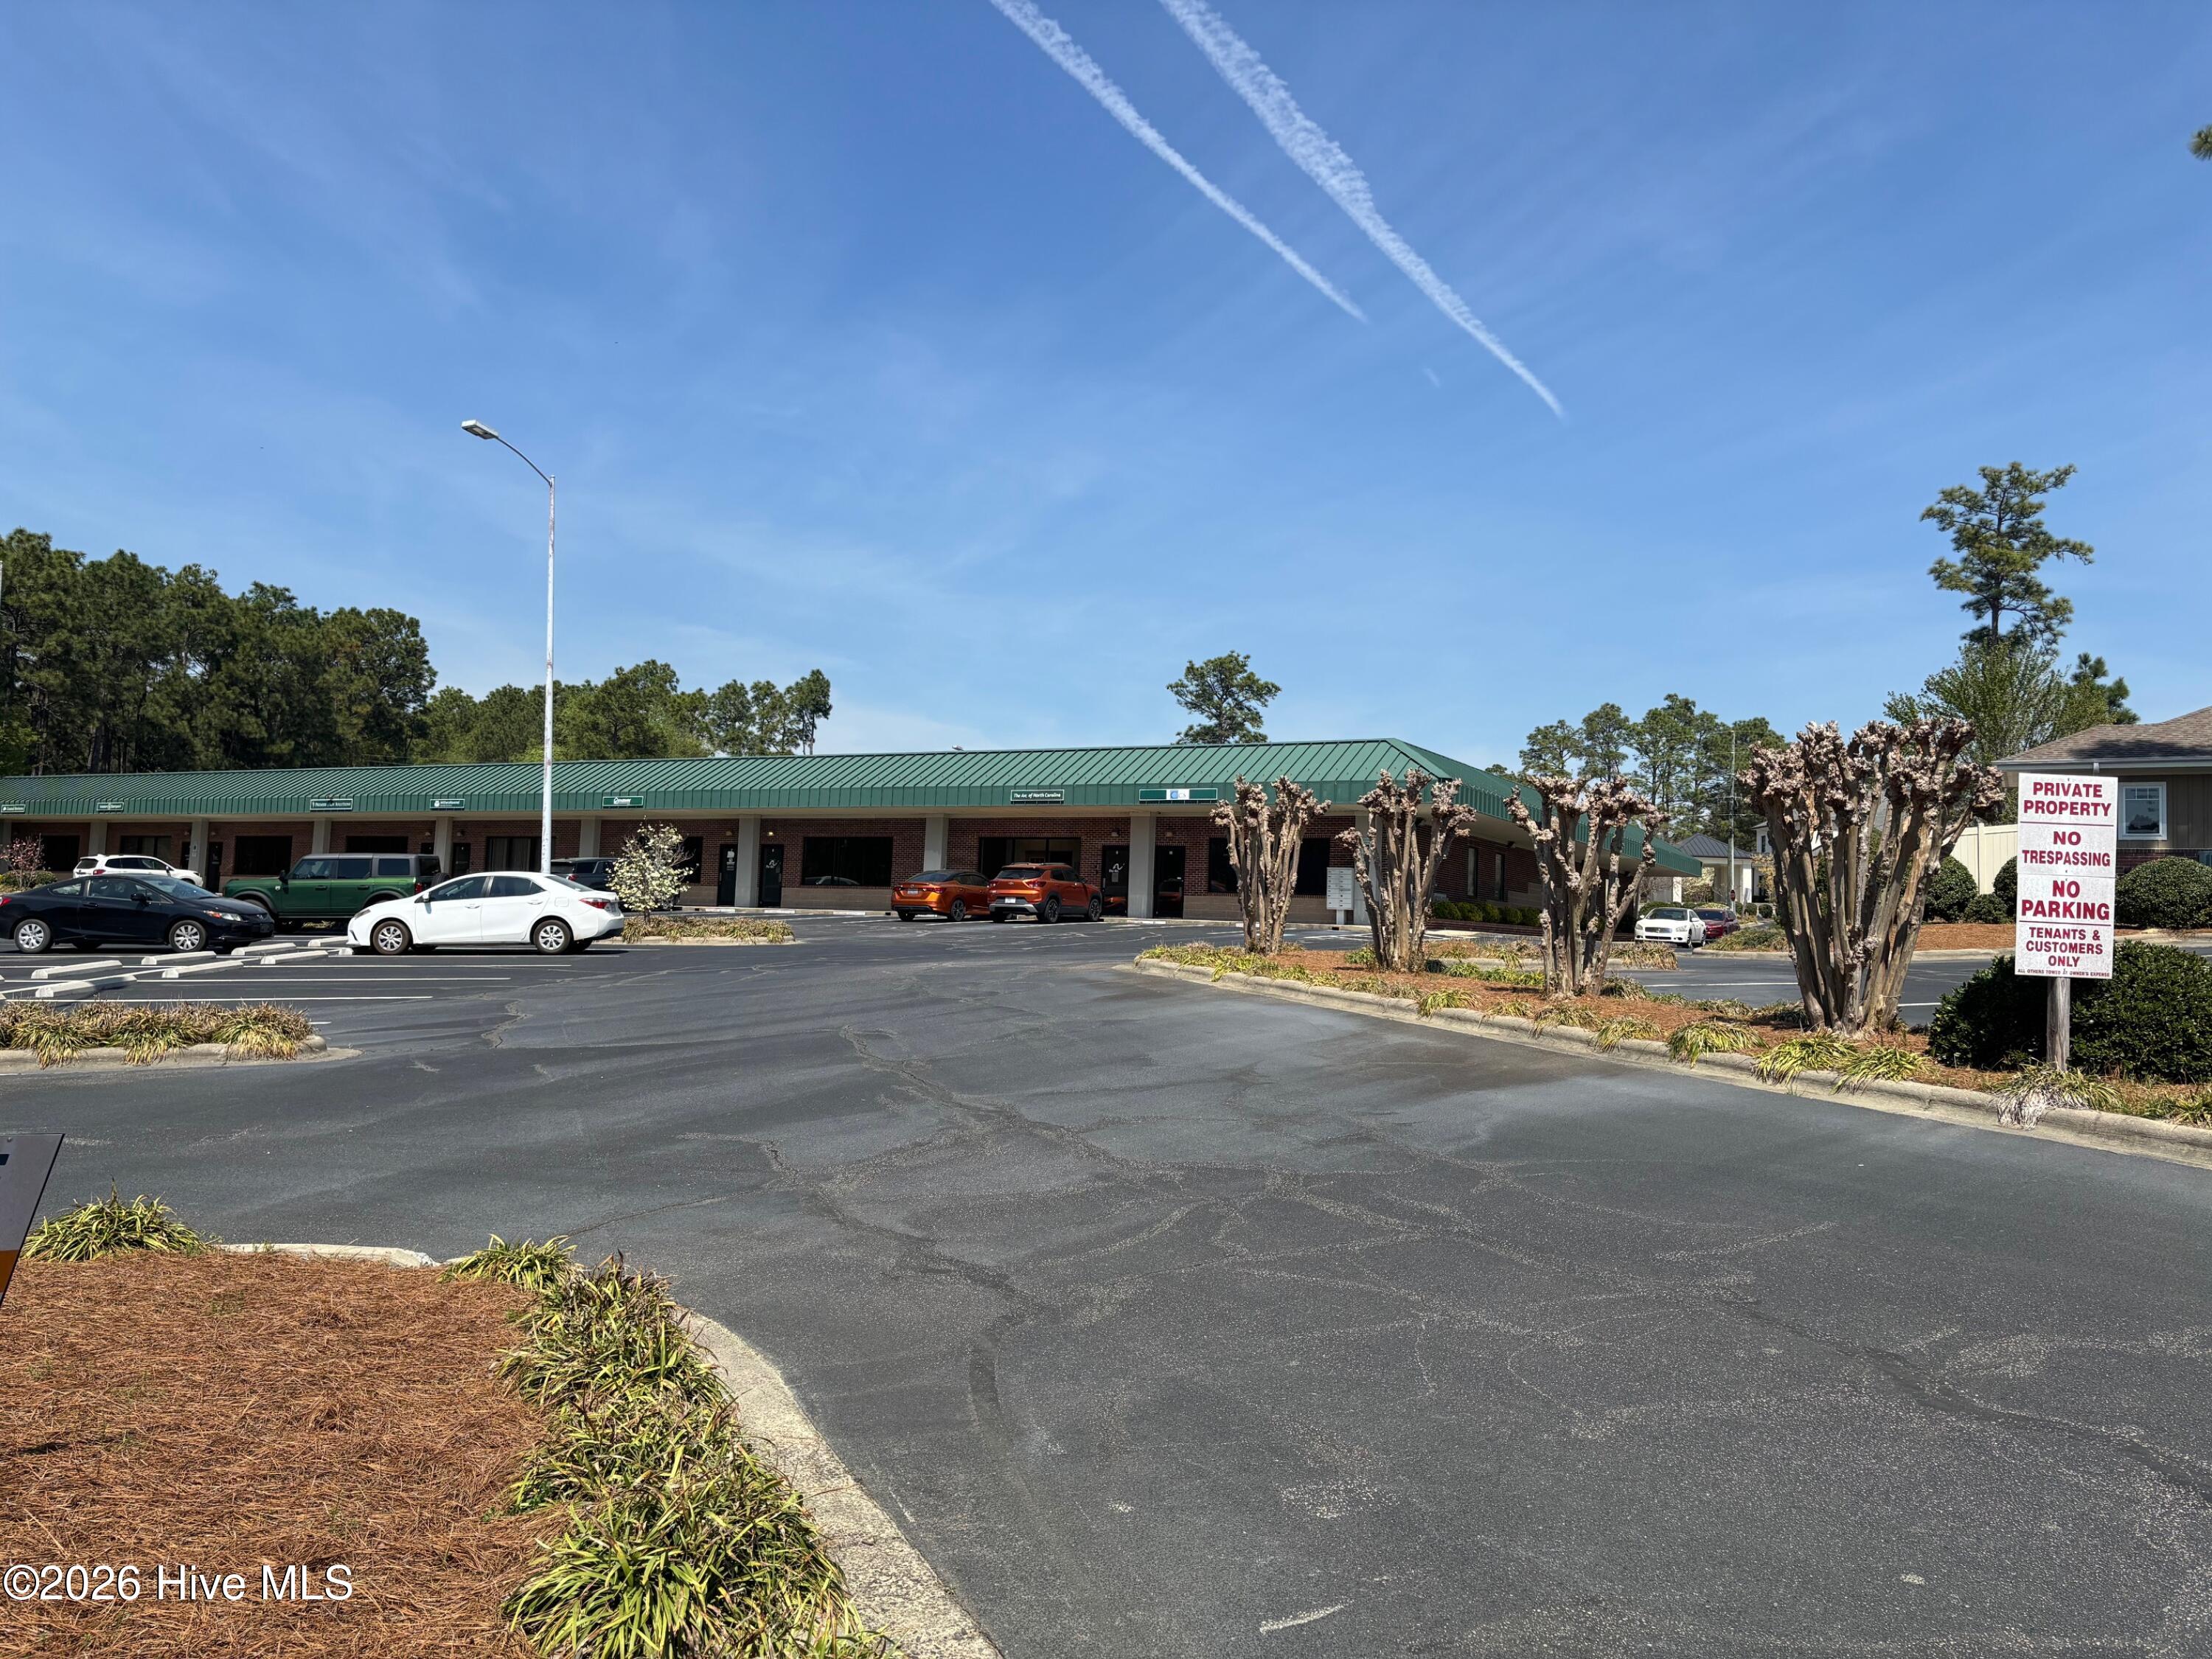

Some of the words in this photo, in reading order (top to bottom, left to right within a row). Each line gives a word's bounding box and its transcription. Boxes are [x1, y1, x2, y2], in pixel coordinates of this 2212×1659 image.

[2033, 782, 2103, 798] PRIVATE
[2023, 800, 2112, 816] PROPERTY
[2053, 831, 2081, 846] NO
[2022, 849, 2110, 866] TRESPASSING
[2052, 880, 2080, 898] NO
[2021, 900, 2110, 920] PARKING
[2029, 927, 2087, 940] TENANTS
[2092, 930, 2101, 941] &
[2025, 940, 2104, 955] CUSTOMERS
[2048, 956, 2080, 967] ONLY
